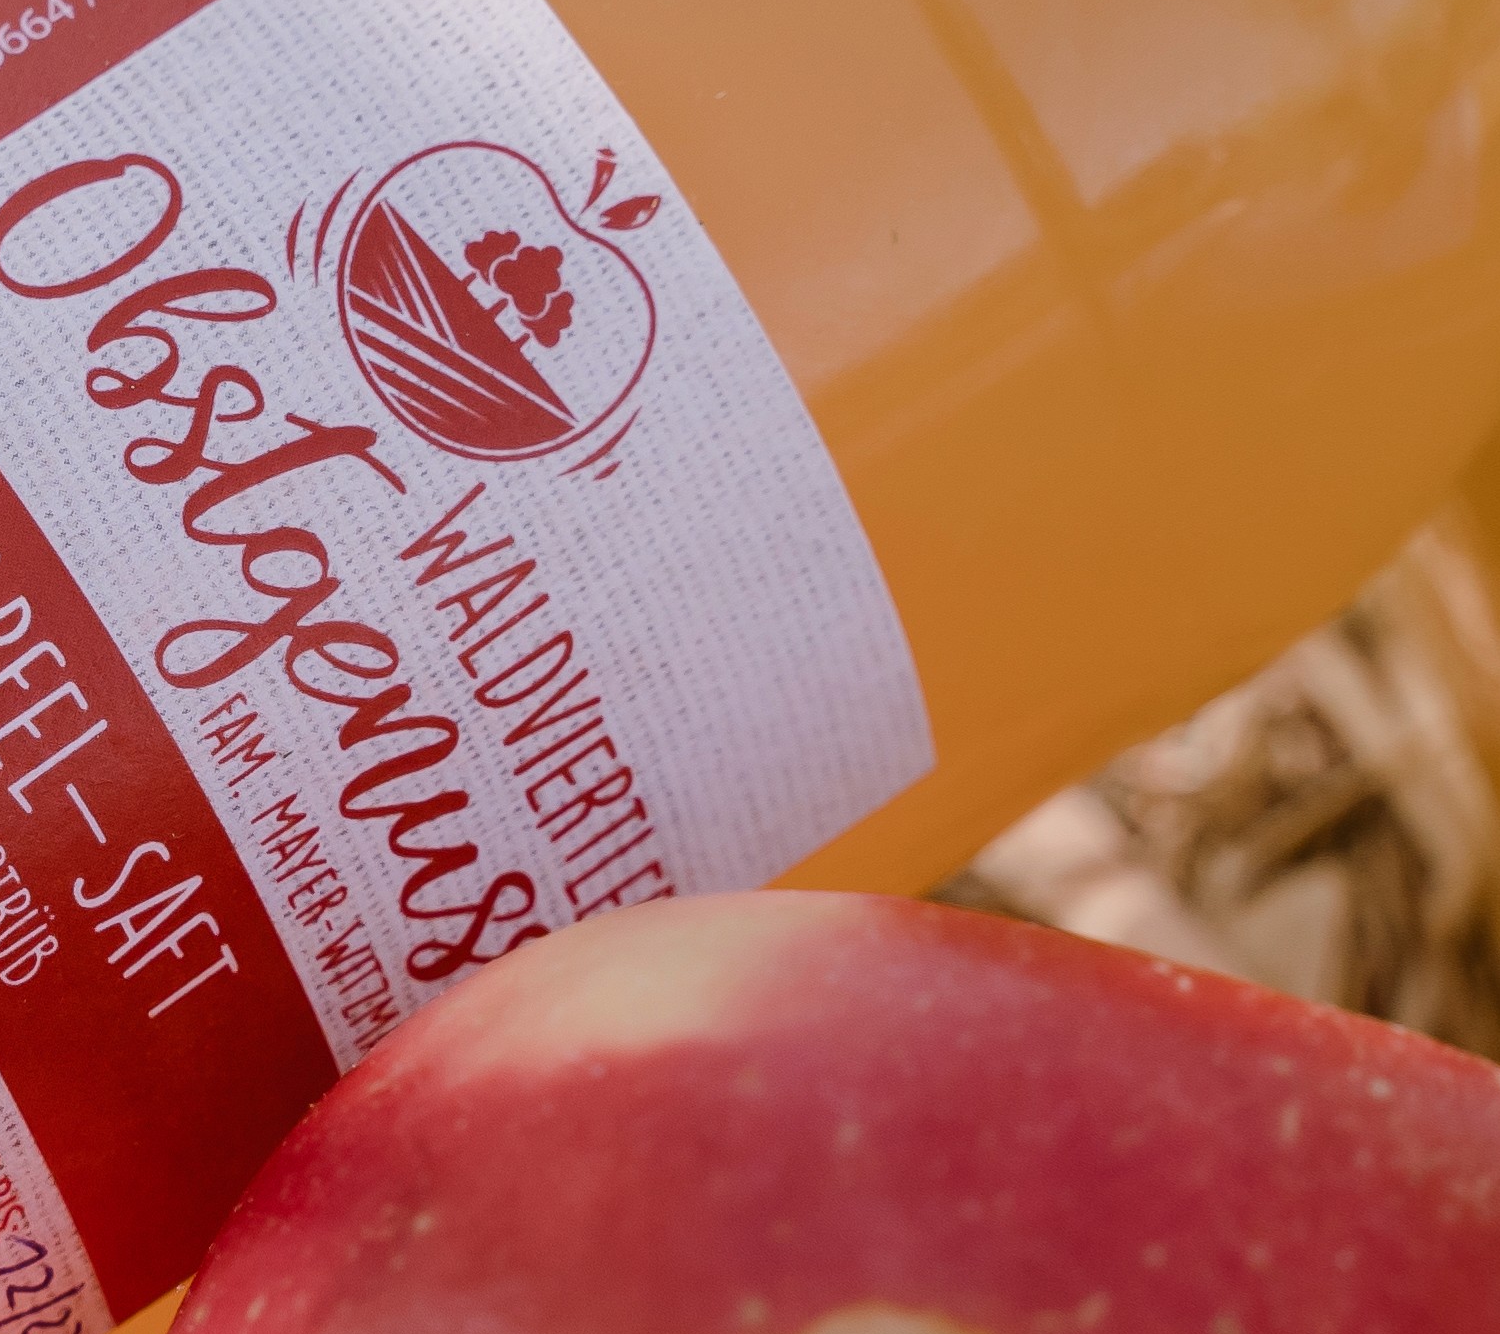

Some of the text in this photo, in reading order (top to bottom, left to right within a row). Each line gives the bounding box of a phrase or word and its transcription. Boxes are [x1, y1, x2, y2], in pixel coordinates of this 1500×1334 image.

[199, 692, 403, 1053] FAM. MAYER-WITZM
[400, 482, 675, 922] WALDVIERTLE
